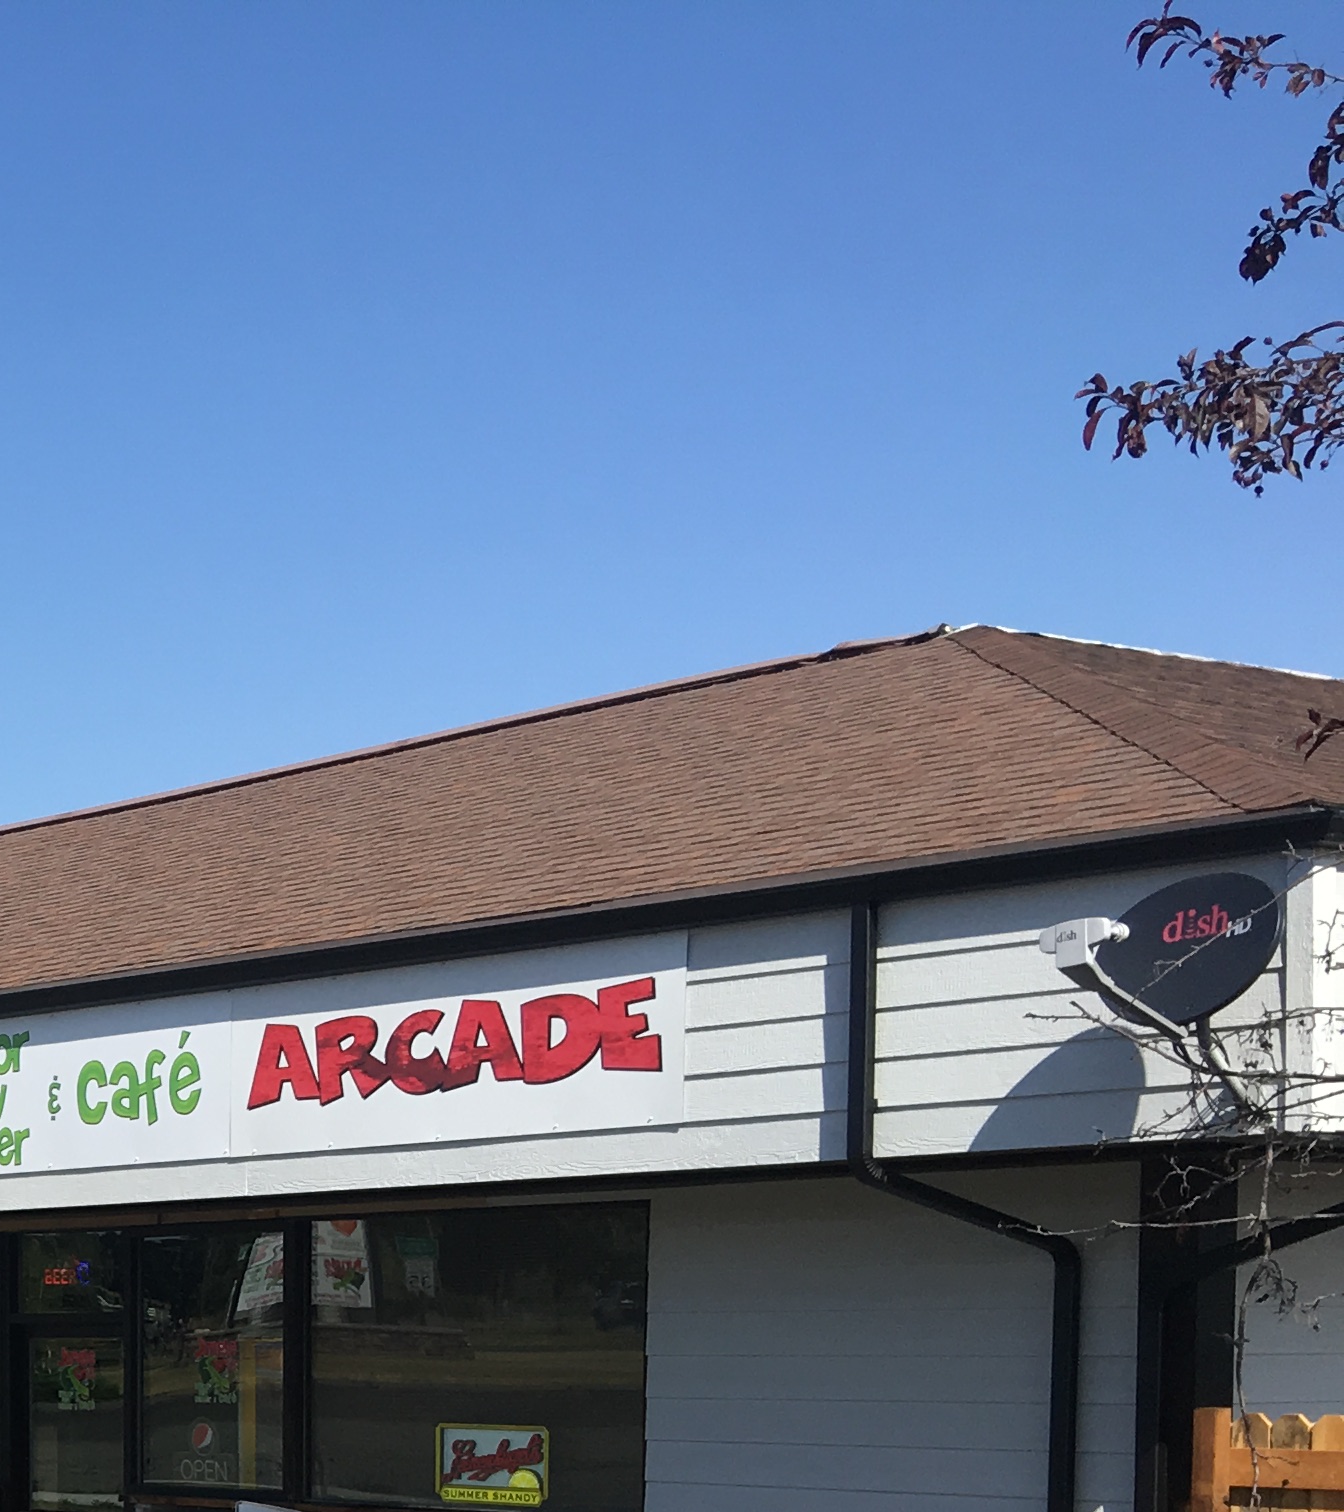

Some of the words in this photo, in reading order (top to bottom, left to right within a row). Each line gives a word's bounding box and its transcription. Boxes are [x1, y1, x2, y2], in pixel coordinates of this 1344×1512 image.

[1162, 904, 1229, 943] dish
[1056, 929, 1077, 943] dish
[247, 976, 663, 1110] ARCADE
[180, 1459, 228, 1481] OPEN
[443, 1488, 489, 1500] SUMMER
[492, 1491, 539, 1503] SHANDY
